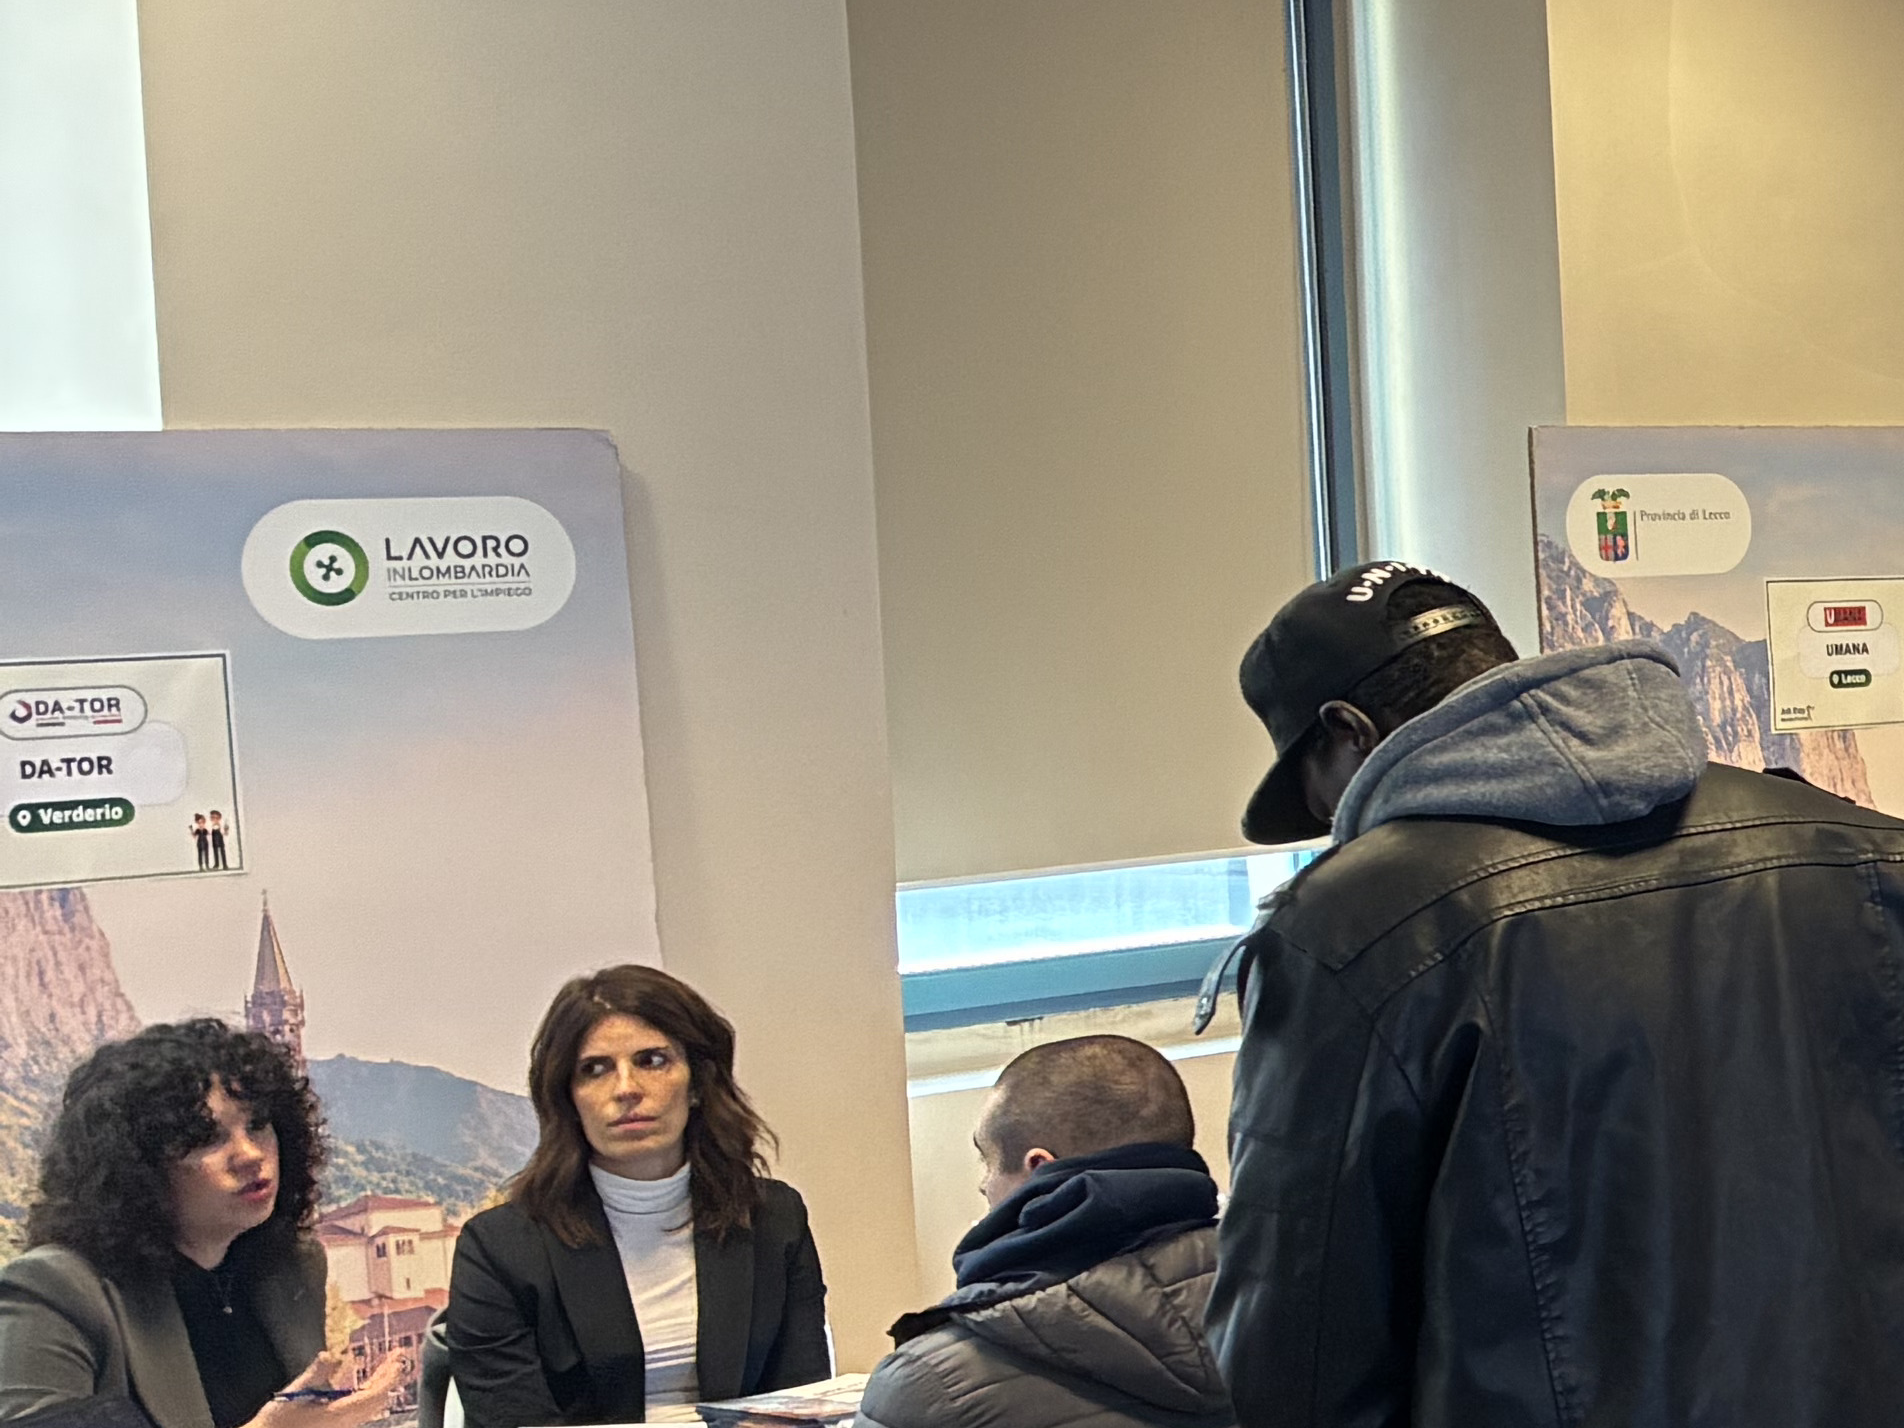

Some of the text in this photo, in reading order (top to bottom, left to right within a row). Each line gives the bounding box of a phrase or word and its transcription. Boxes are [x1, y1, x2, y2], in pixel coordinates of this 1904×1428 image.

[385, 534, 529, 561] LAVORO
[386, 563, 531, 582] INLOMBARDIA
[388, 589, 441, 602] CENTRO
[443, 588, 468, 600] PER
[1826, 642, 1869, 657] UMANA
[34, 697, 122, 716] DA-TOR
[20, 756, 114, 780] DA-TOR
[38, 804, 124, 825] Verderio
